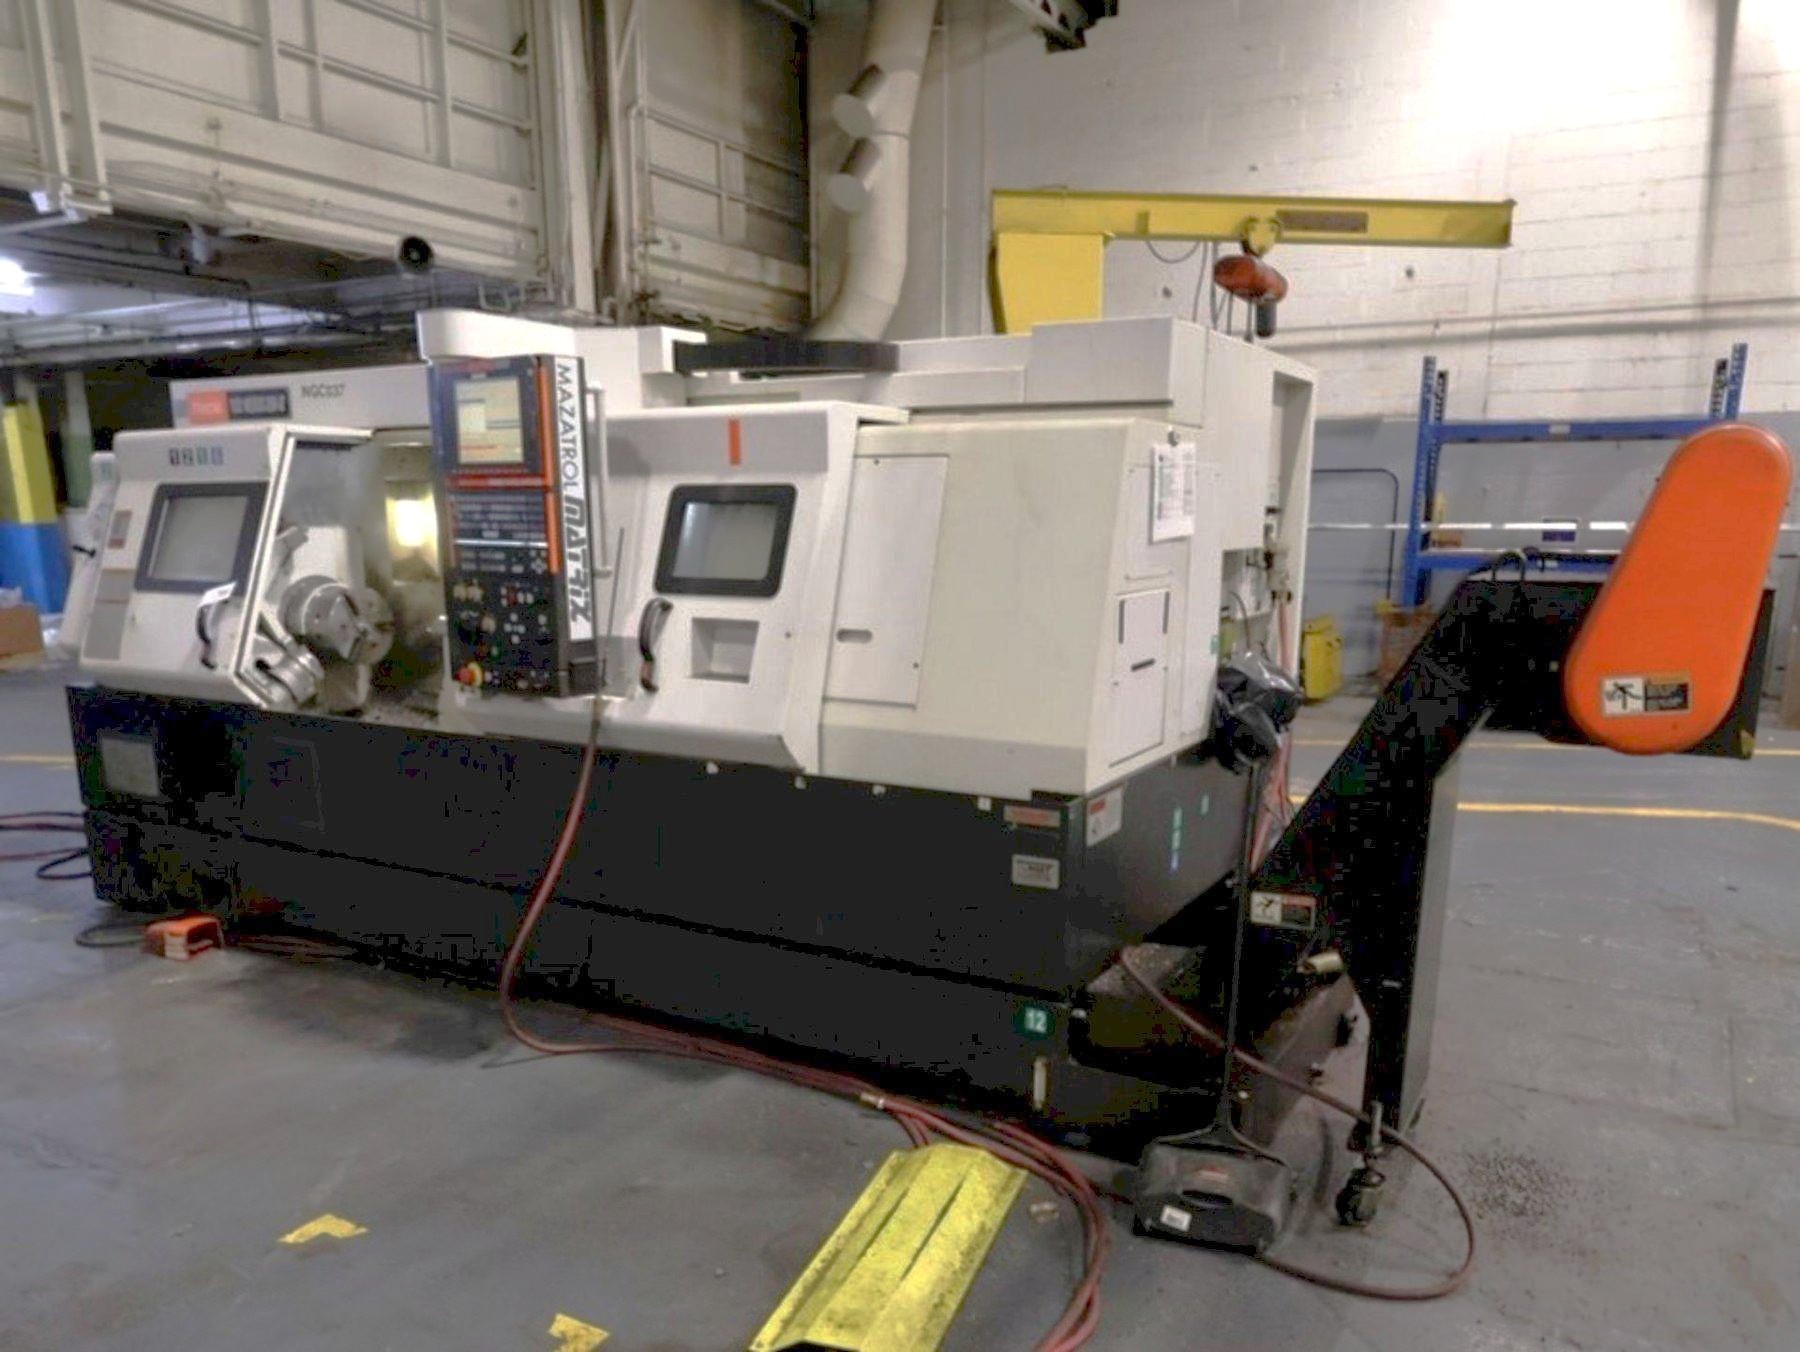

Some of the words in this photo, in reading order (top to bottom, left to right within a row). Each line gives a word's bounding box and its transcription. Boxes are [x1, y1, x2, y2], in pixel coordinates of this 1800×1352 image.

[557, 363, 579, 491] MAZATROL
[564, 494, 592, 623] MATRIX
[1025, 1006, 1047, 1033] 12
